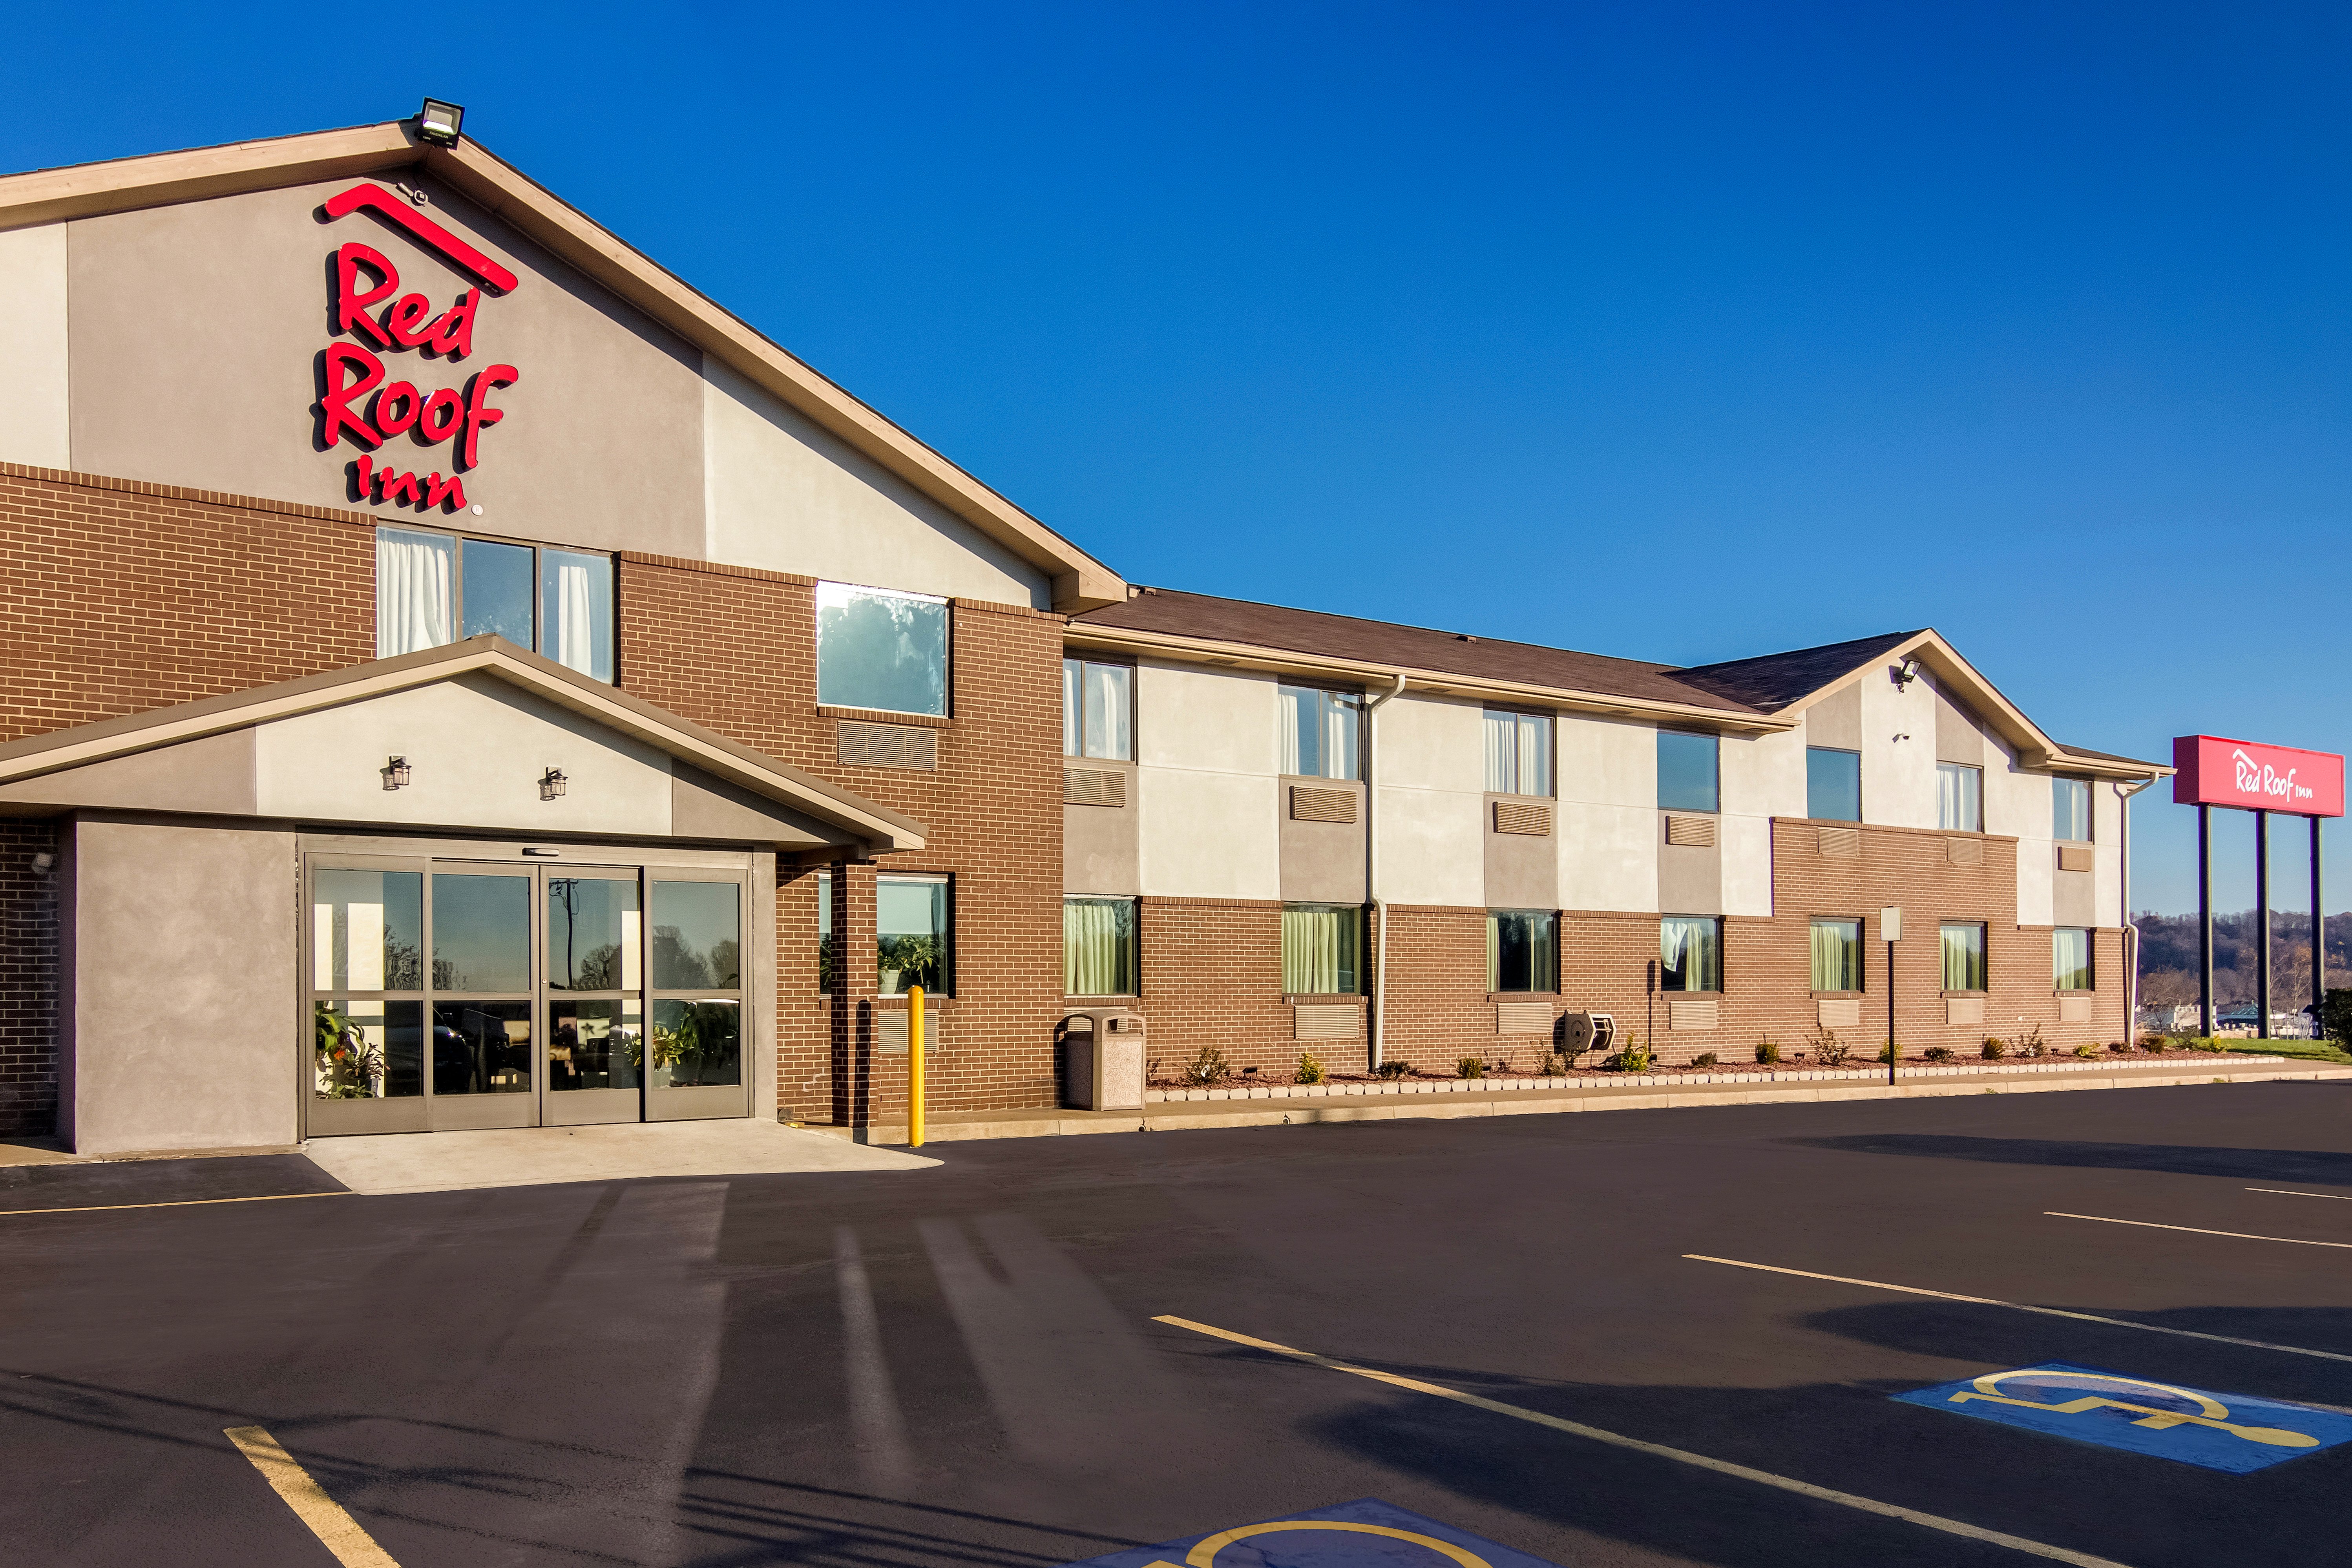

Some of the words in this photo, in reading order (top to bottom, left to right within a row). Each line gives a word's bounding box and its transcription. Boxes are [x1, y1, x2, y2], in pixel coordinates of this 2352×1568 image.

[338, 241, 480, 358] Red
[321, 341, 519, 469] Roof
[356, 454, 467, 509] Inn
[2236, 760, 2261, 793] Red
[2264, 764, 2297, 803] Roof
[2295, 785, 2313, 798] Inn
